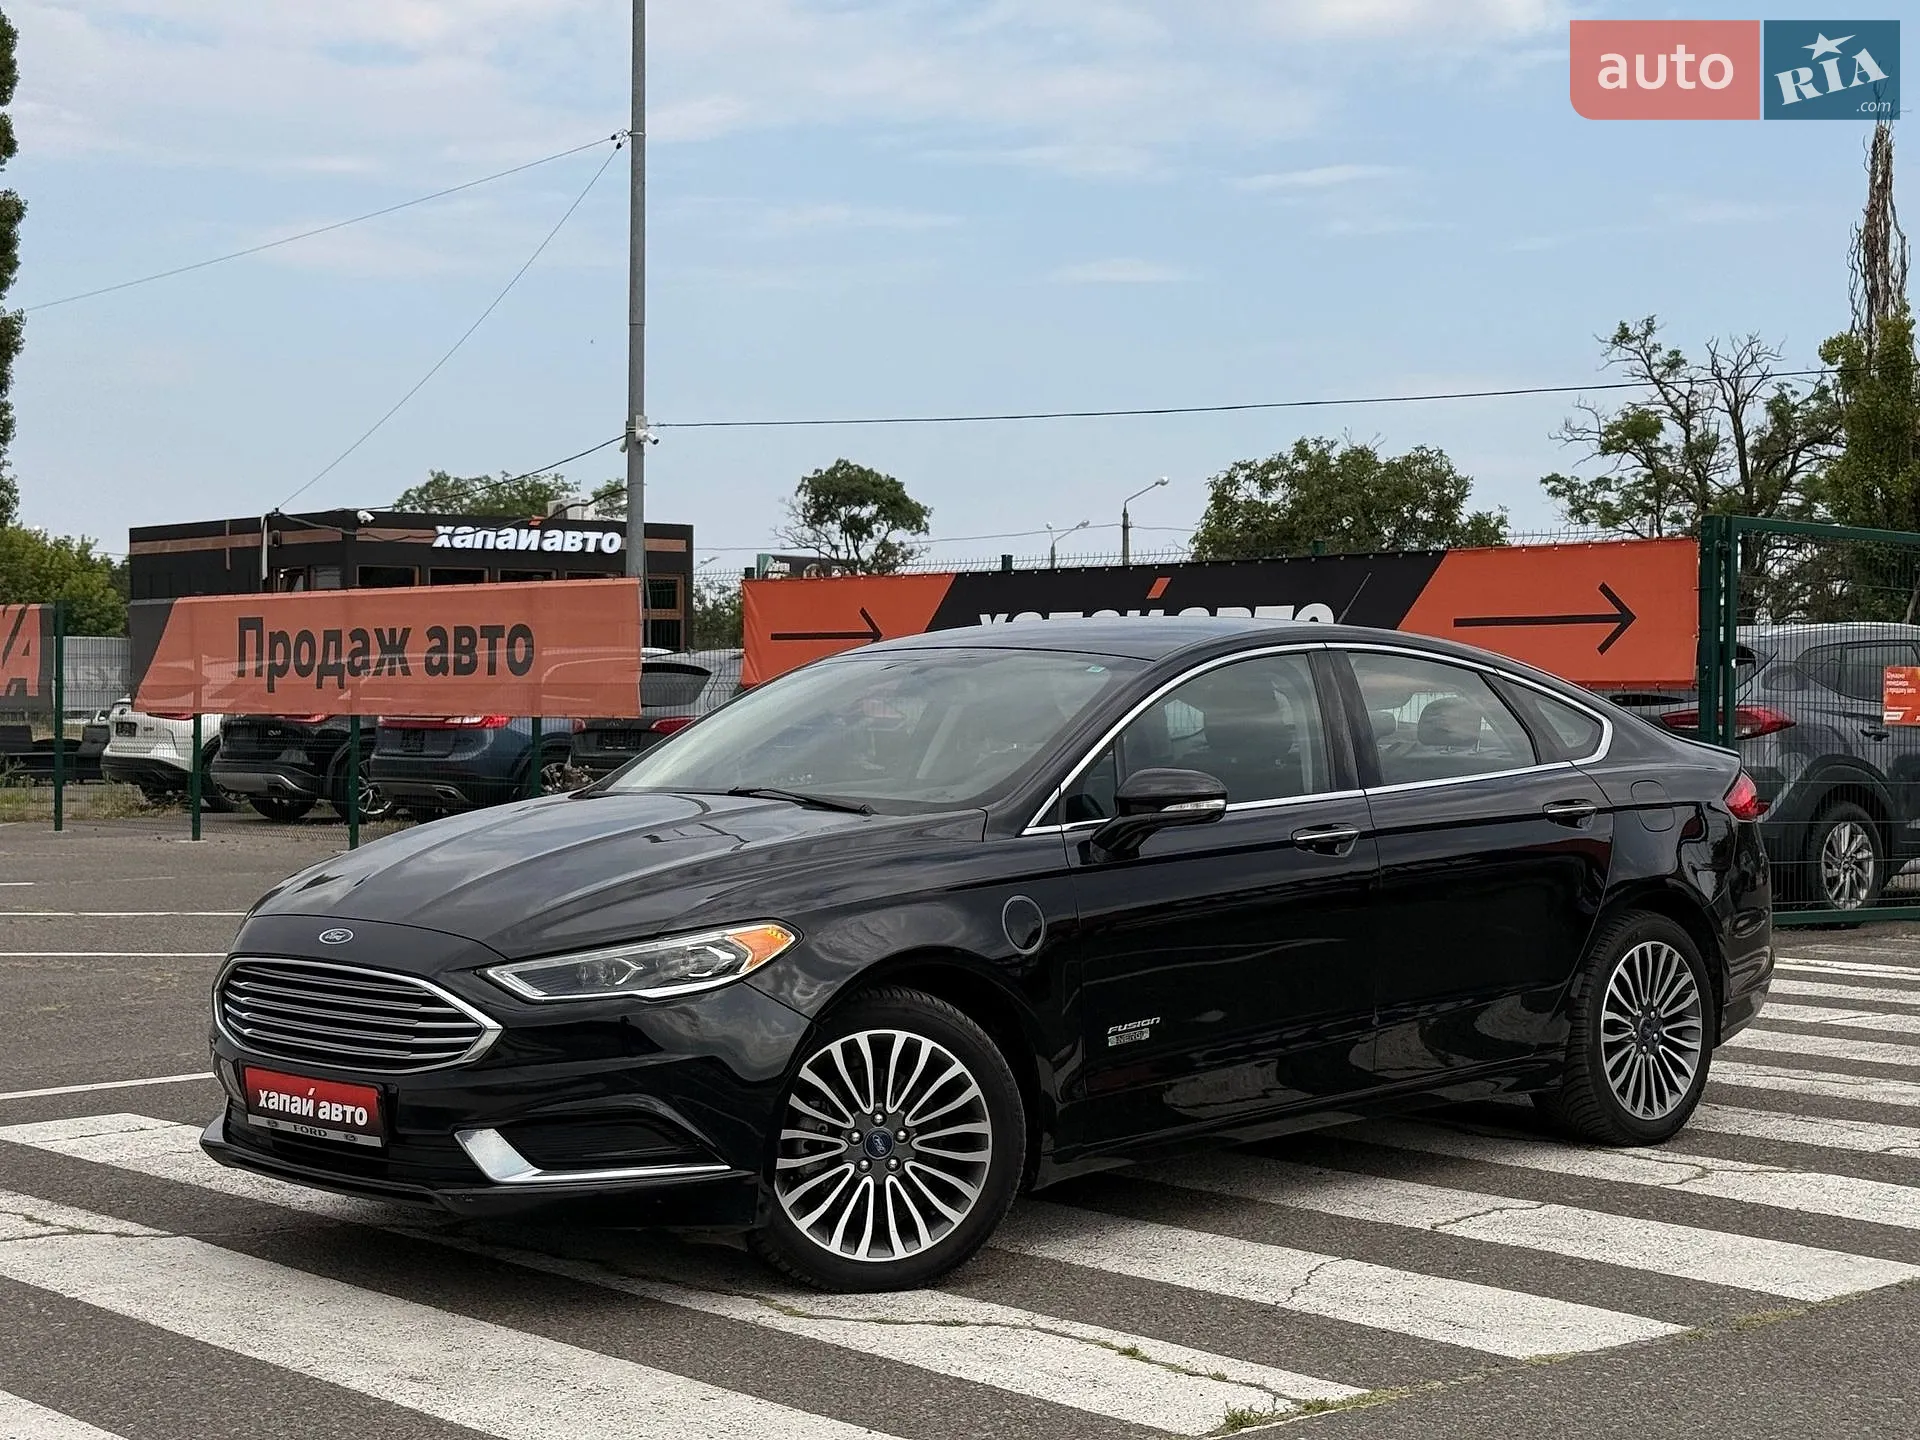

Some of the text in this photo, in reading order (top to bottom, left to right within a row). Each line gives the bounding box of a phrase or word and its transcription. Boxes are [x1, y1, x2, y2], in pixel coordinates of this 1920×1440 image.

[541, 529, 622, 554] авто
[237, 616, 535, 693] Продаж авто
[258, 1087, 368, 1127] хапай авто
[293, 1124, 328, 1138] FORD
